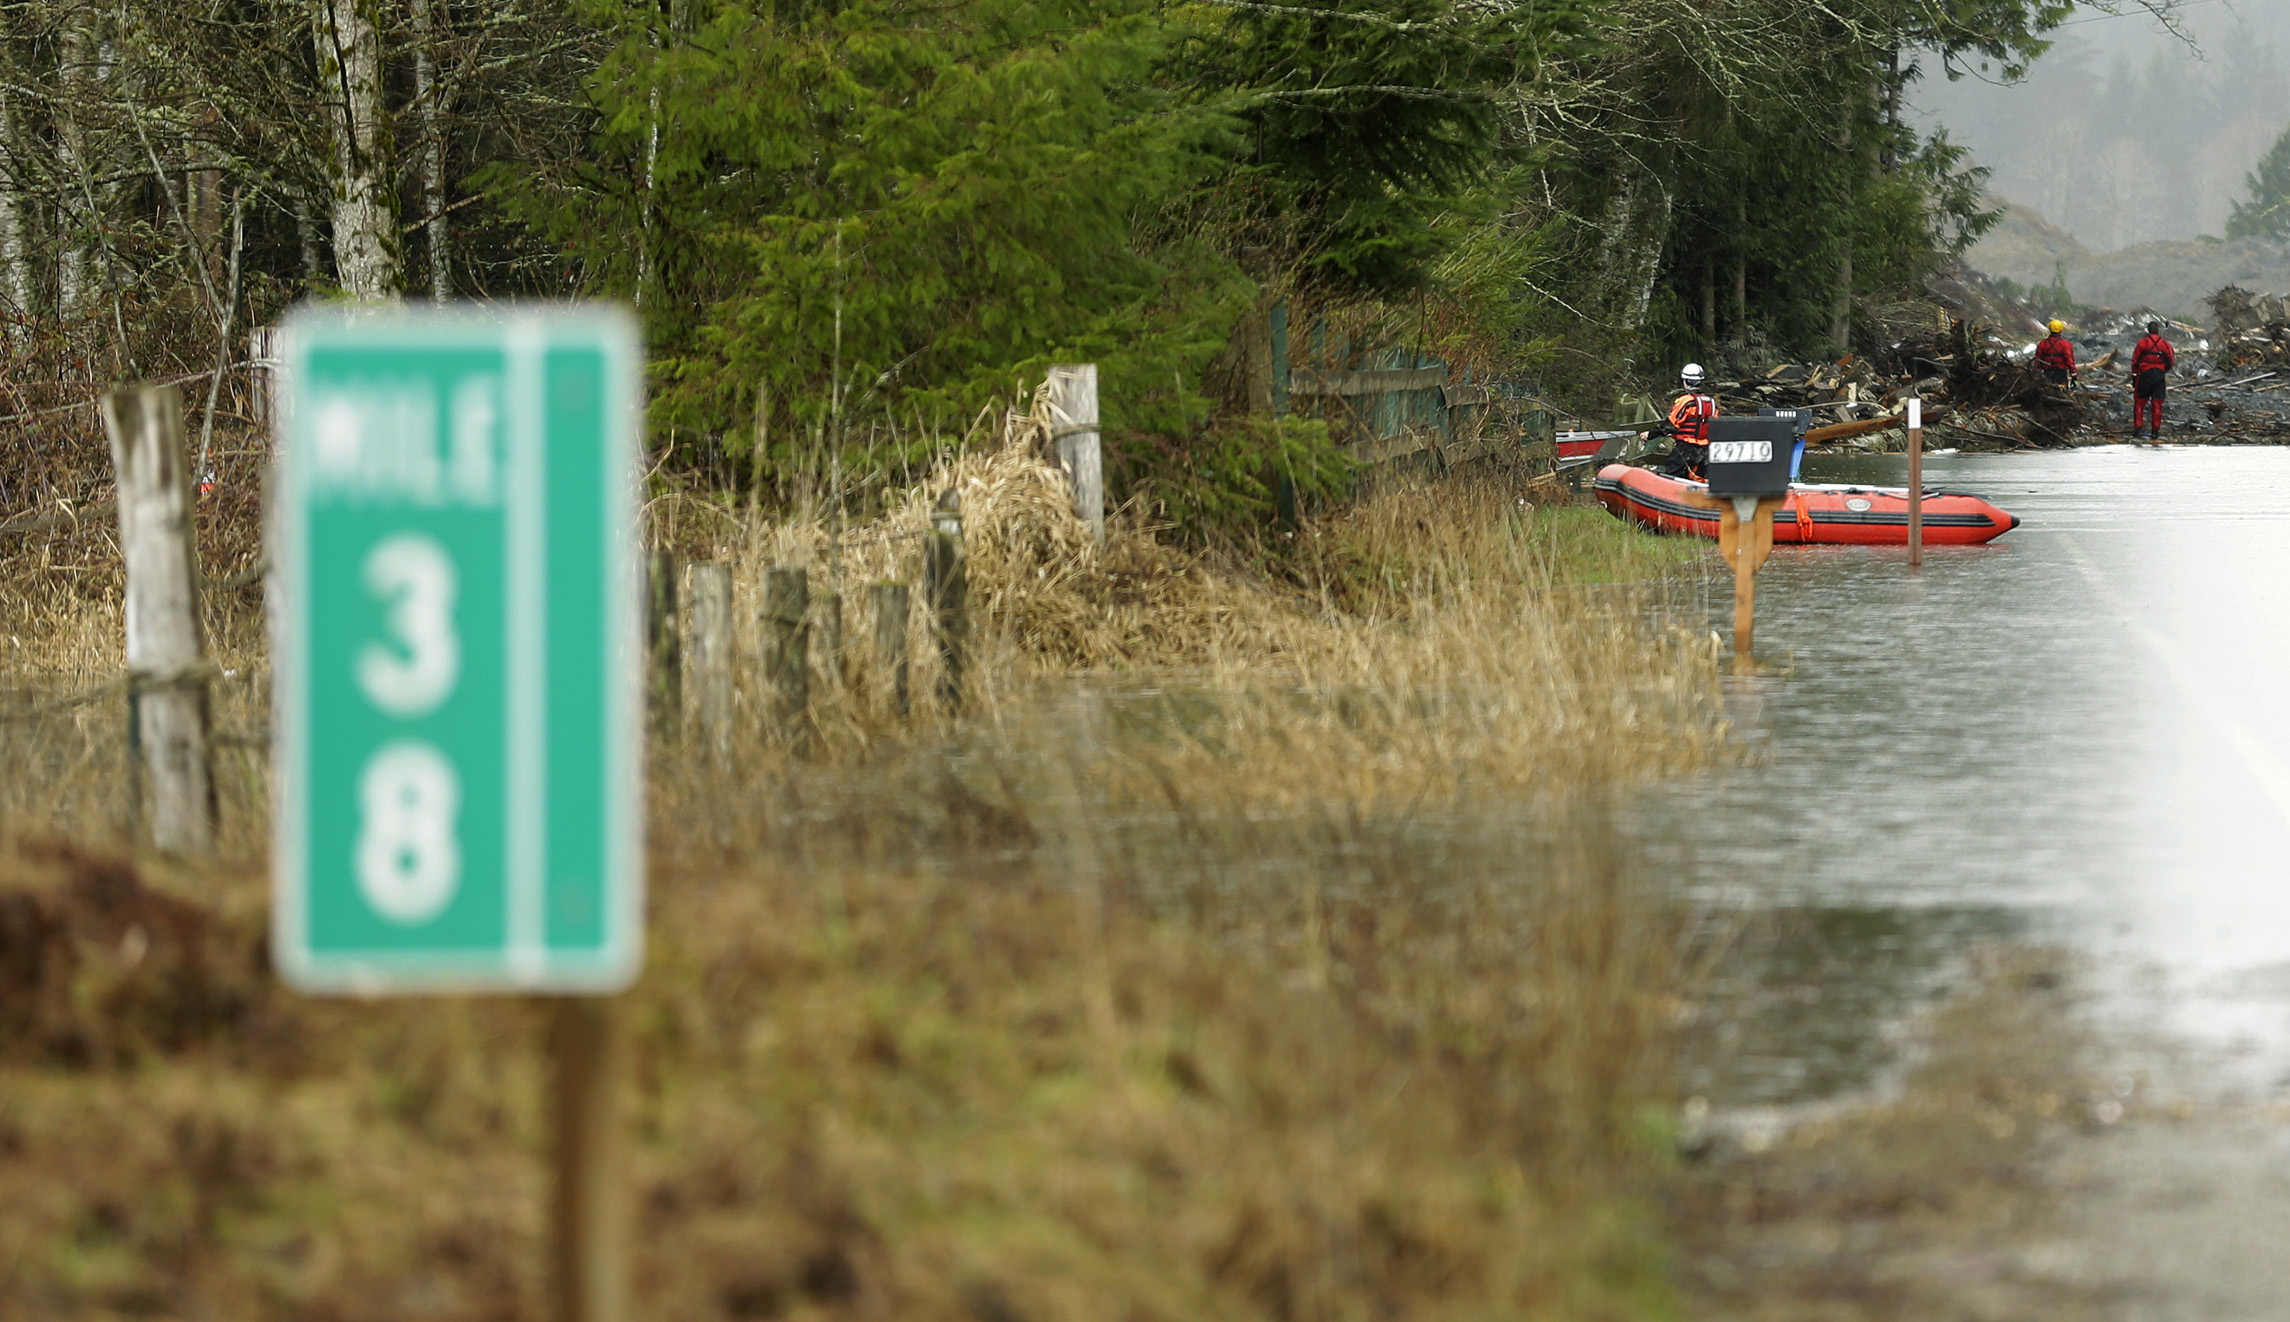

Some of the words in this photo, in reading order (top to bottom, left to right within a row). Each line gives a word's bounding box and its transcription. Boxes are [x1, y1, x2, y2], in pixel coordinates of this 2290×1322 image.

[309, 374, 502, 508] MILE
[1712, 442, 1771, 462] 29710
[354, 533, 461, 717] 3
[354, 740, 461, 925] 8
